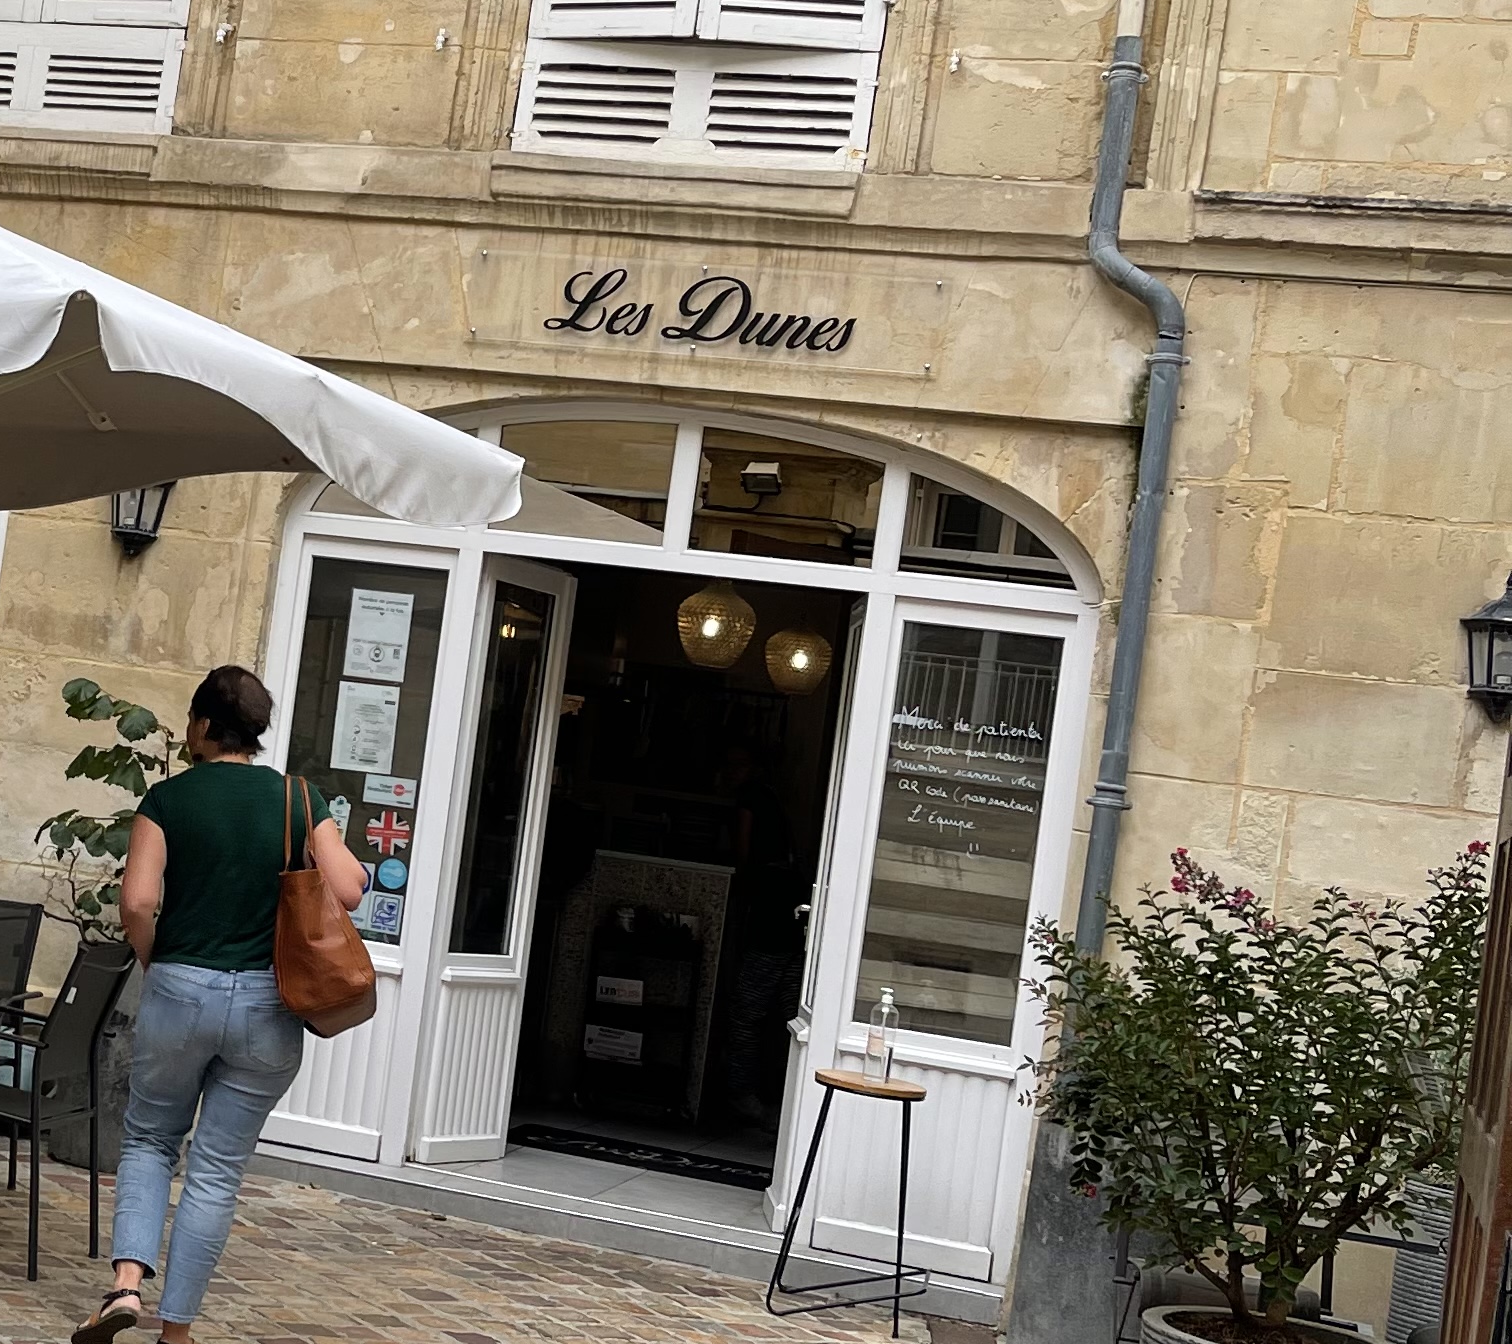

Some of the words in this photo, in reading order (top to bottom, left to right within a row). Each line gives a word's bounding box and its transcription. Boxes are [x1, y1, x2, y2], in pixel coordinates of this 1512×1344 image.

[544, 268, 654, 336] Les
[661, 276, 857, 352] Dunes
[953, 717, 972, 733] de
[923, 745, 957, 761] pour
[964, 750, 988, 763] que
[995, 751, 1025, 763] nous
[898, 779, 921, 794] QR
[925, 785, 949, 798] code
